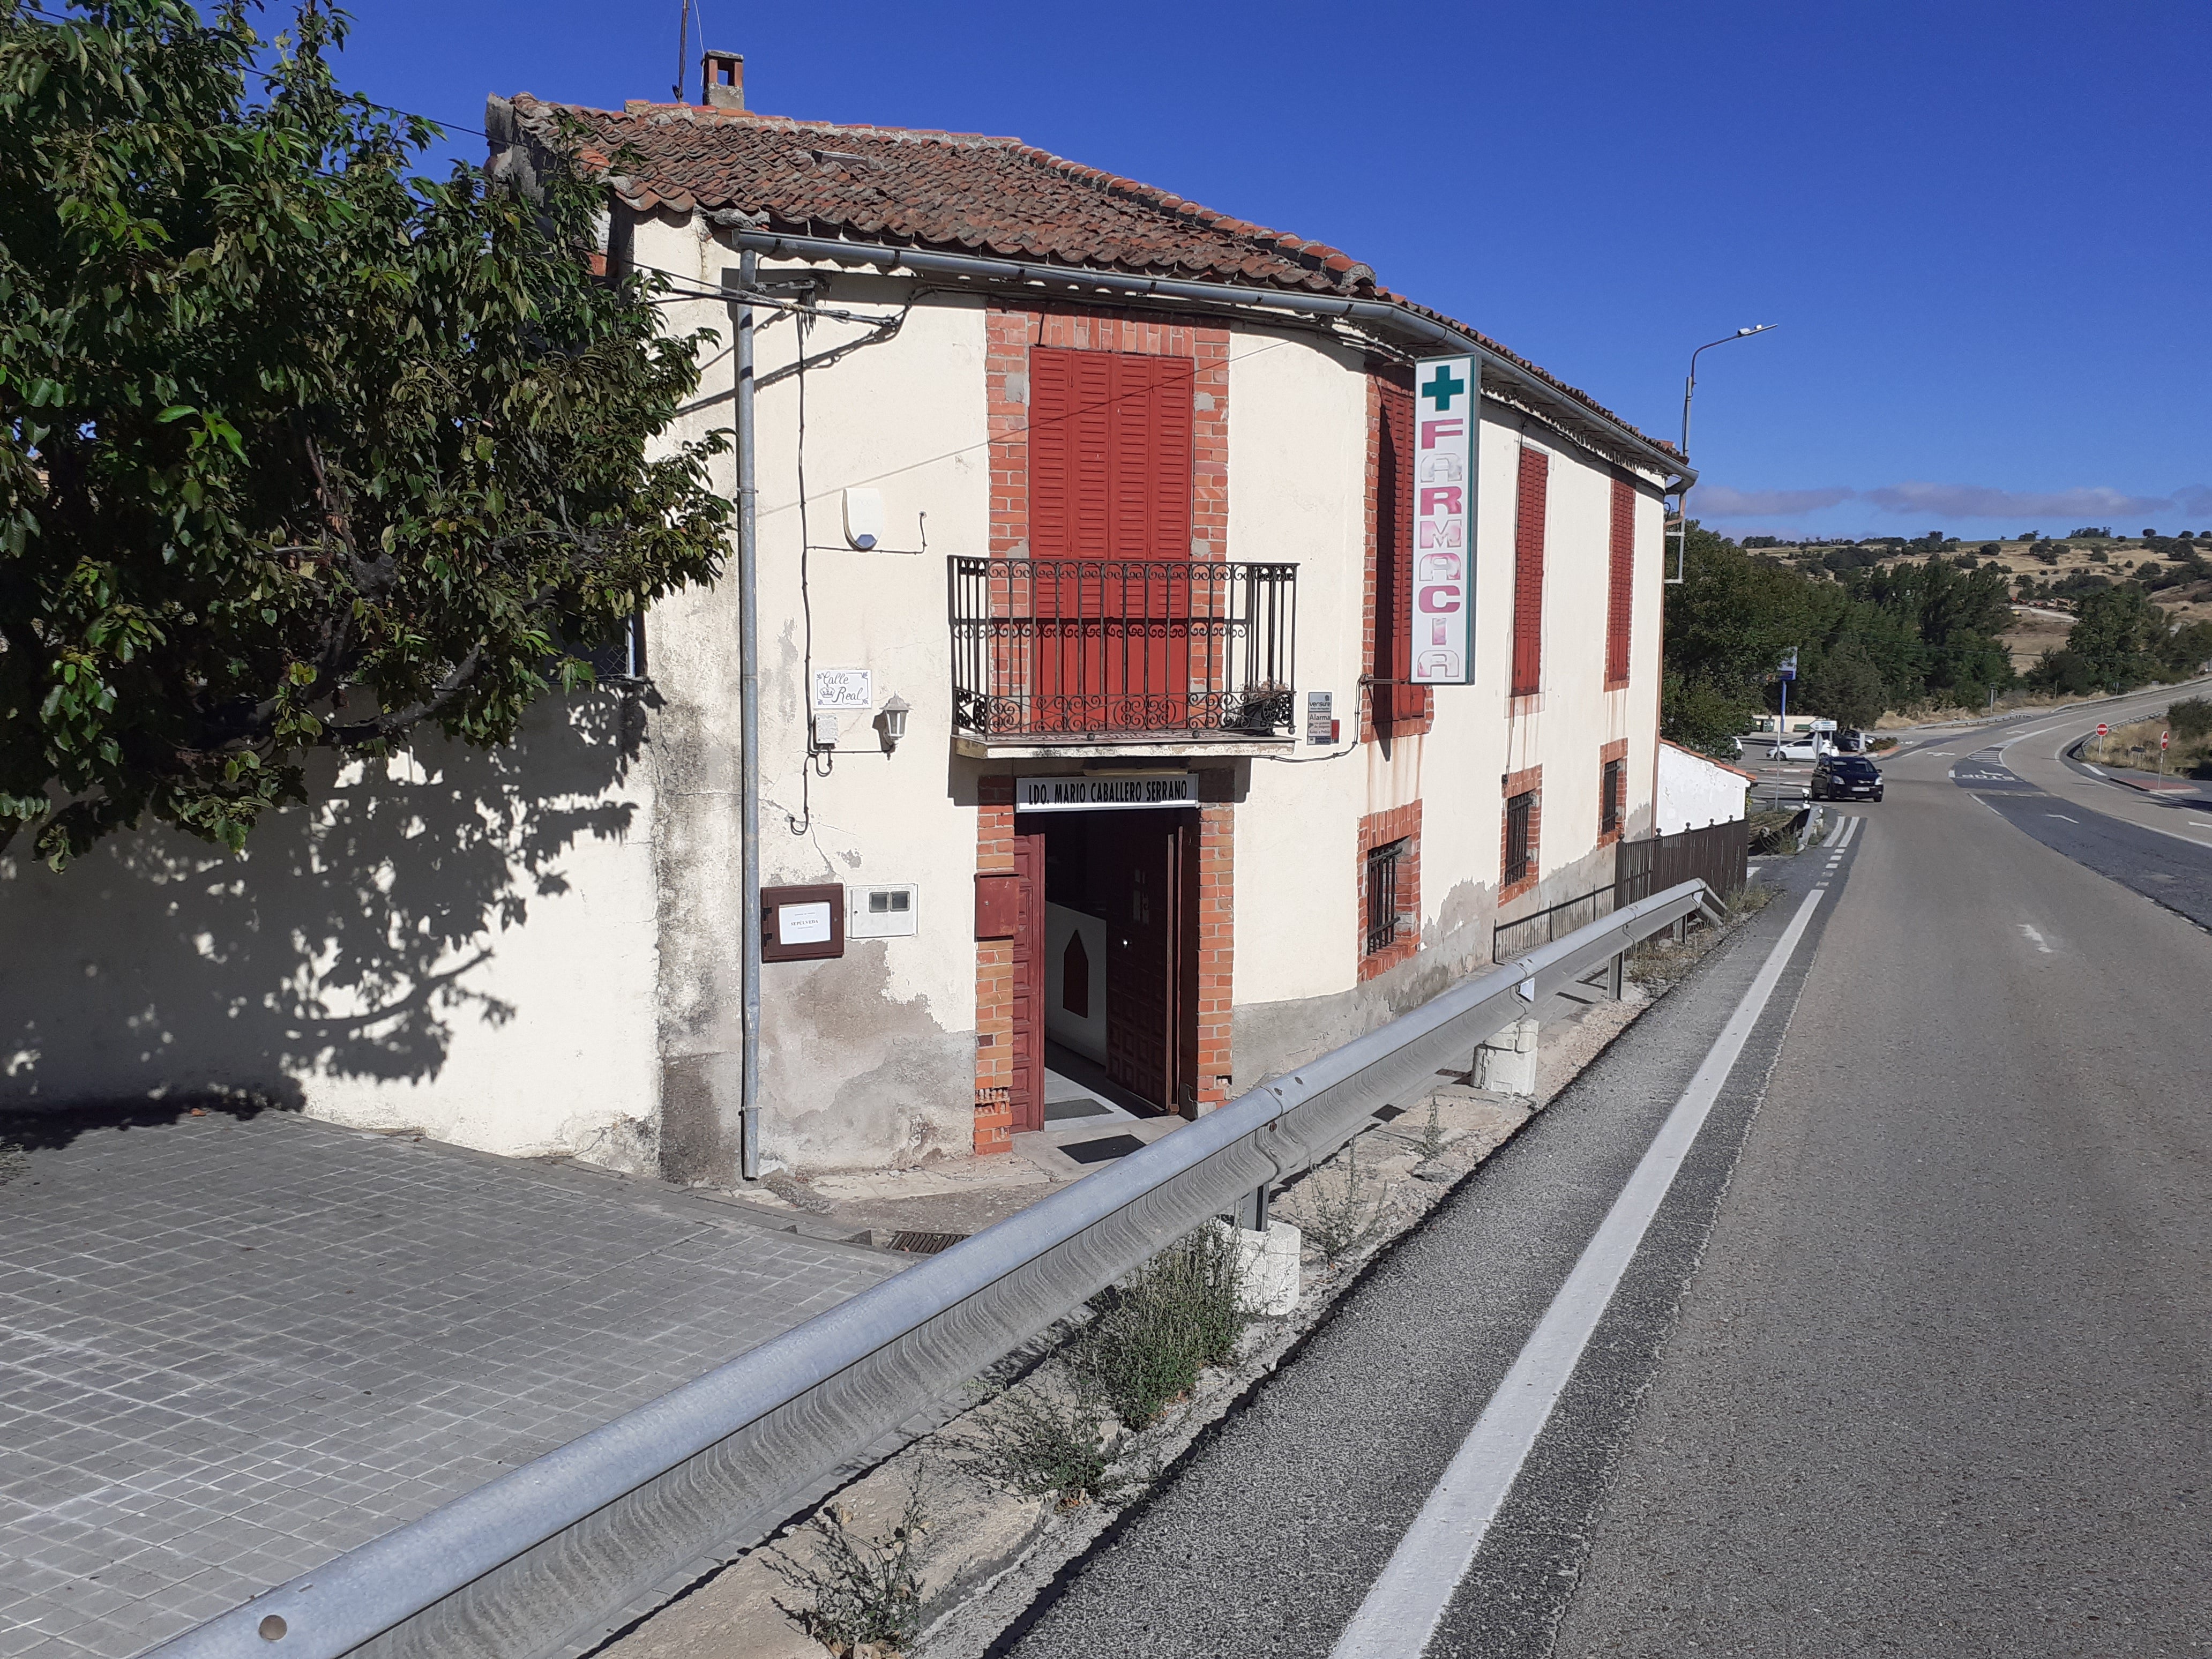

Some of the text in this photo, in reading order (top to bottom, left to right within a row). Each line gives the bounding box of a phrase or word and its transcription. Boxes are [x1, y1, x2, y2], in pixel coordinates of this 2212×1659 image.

[1417, 418, 1463, 677] FARMACIA
[821, 671, 849, 685] Calle
[832, 686, 863, 705] Real
[1029, 780, 1187, 805] LDO. MARIO CABALLERO SERRANO
